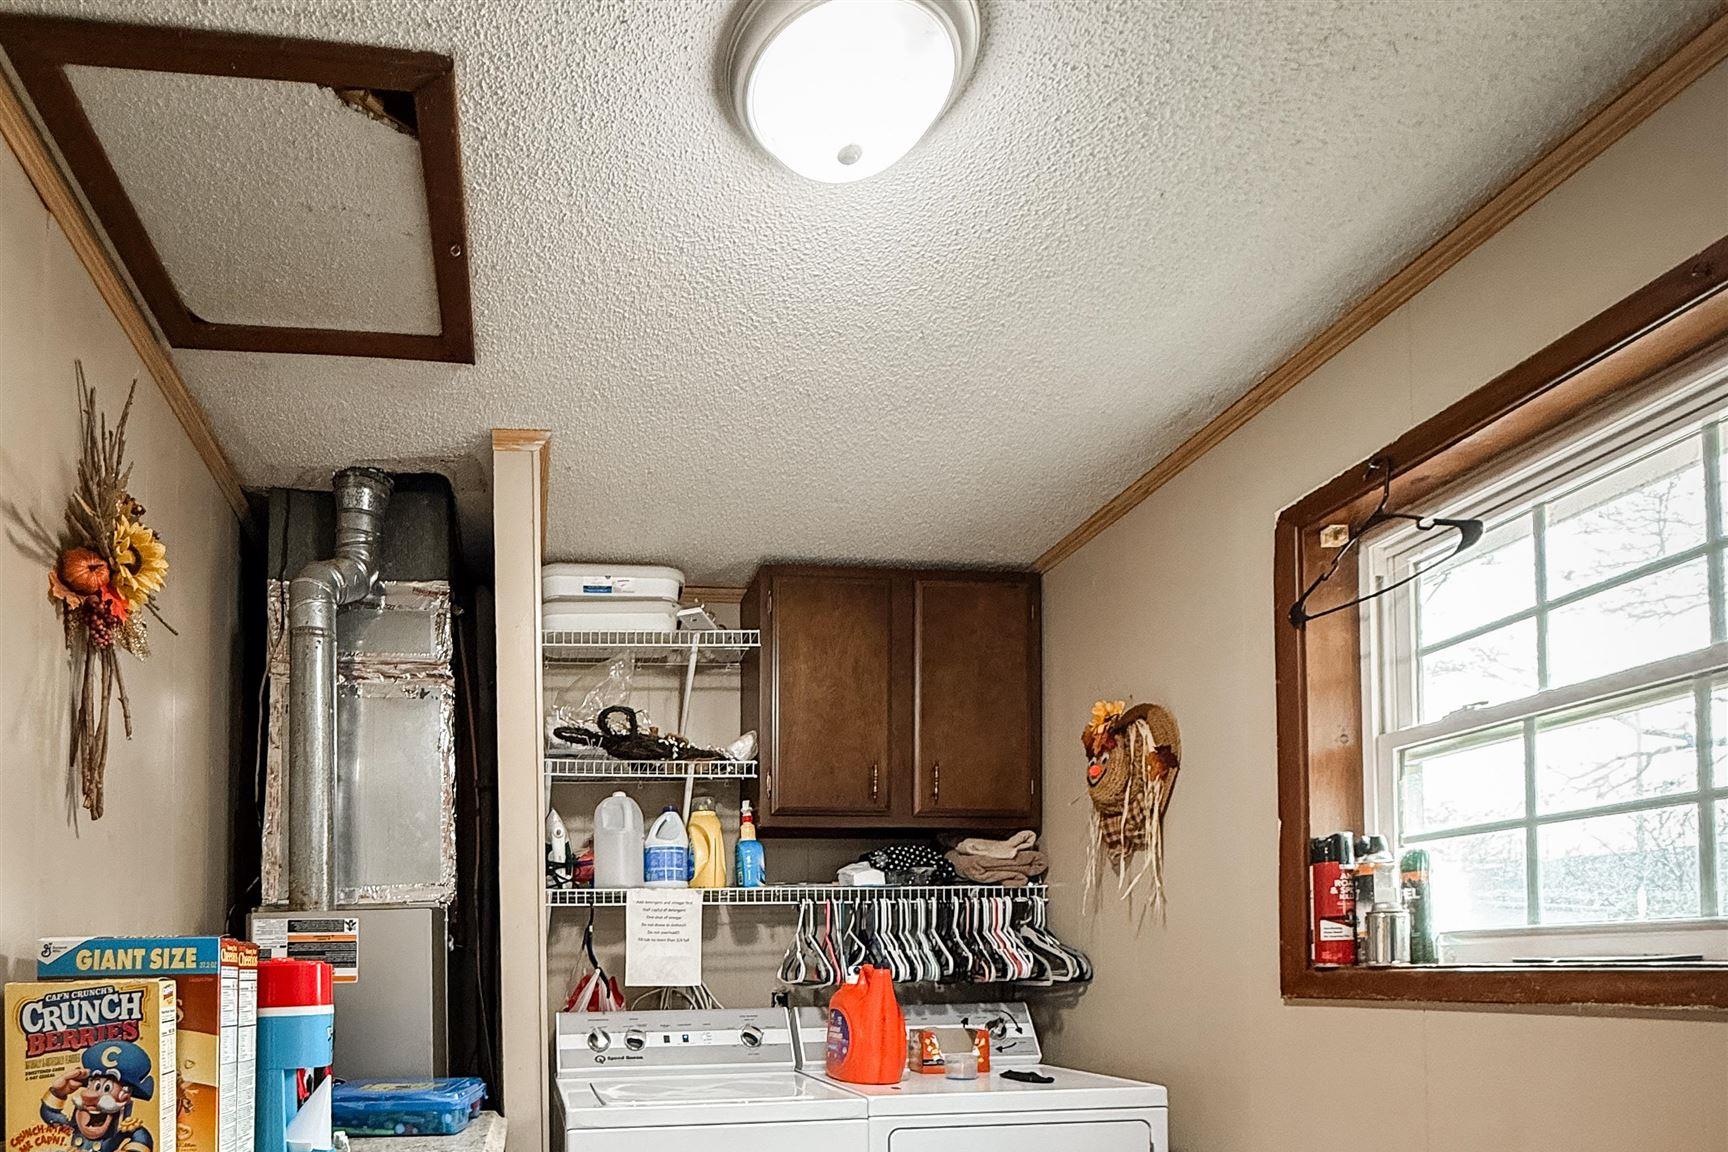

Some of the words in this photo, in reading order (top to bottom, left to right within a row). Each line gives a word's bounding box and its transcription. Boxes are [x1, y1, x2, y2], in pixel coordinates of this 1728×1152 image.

[75, 948, 146, 971] GIANT
[150, 947, 198, 969] SIZE
[45, 992, 70, 1002] CAP'N
[71, 986, 114, 999] CRUNCH'S
[22, 992, 142, 1033] CRUNCH
[27, 1020, 140, 1057] BERRIES
[101, 1046, 122, 1068] C
